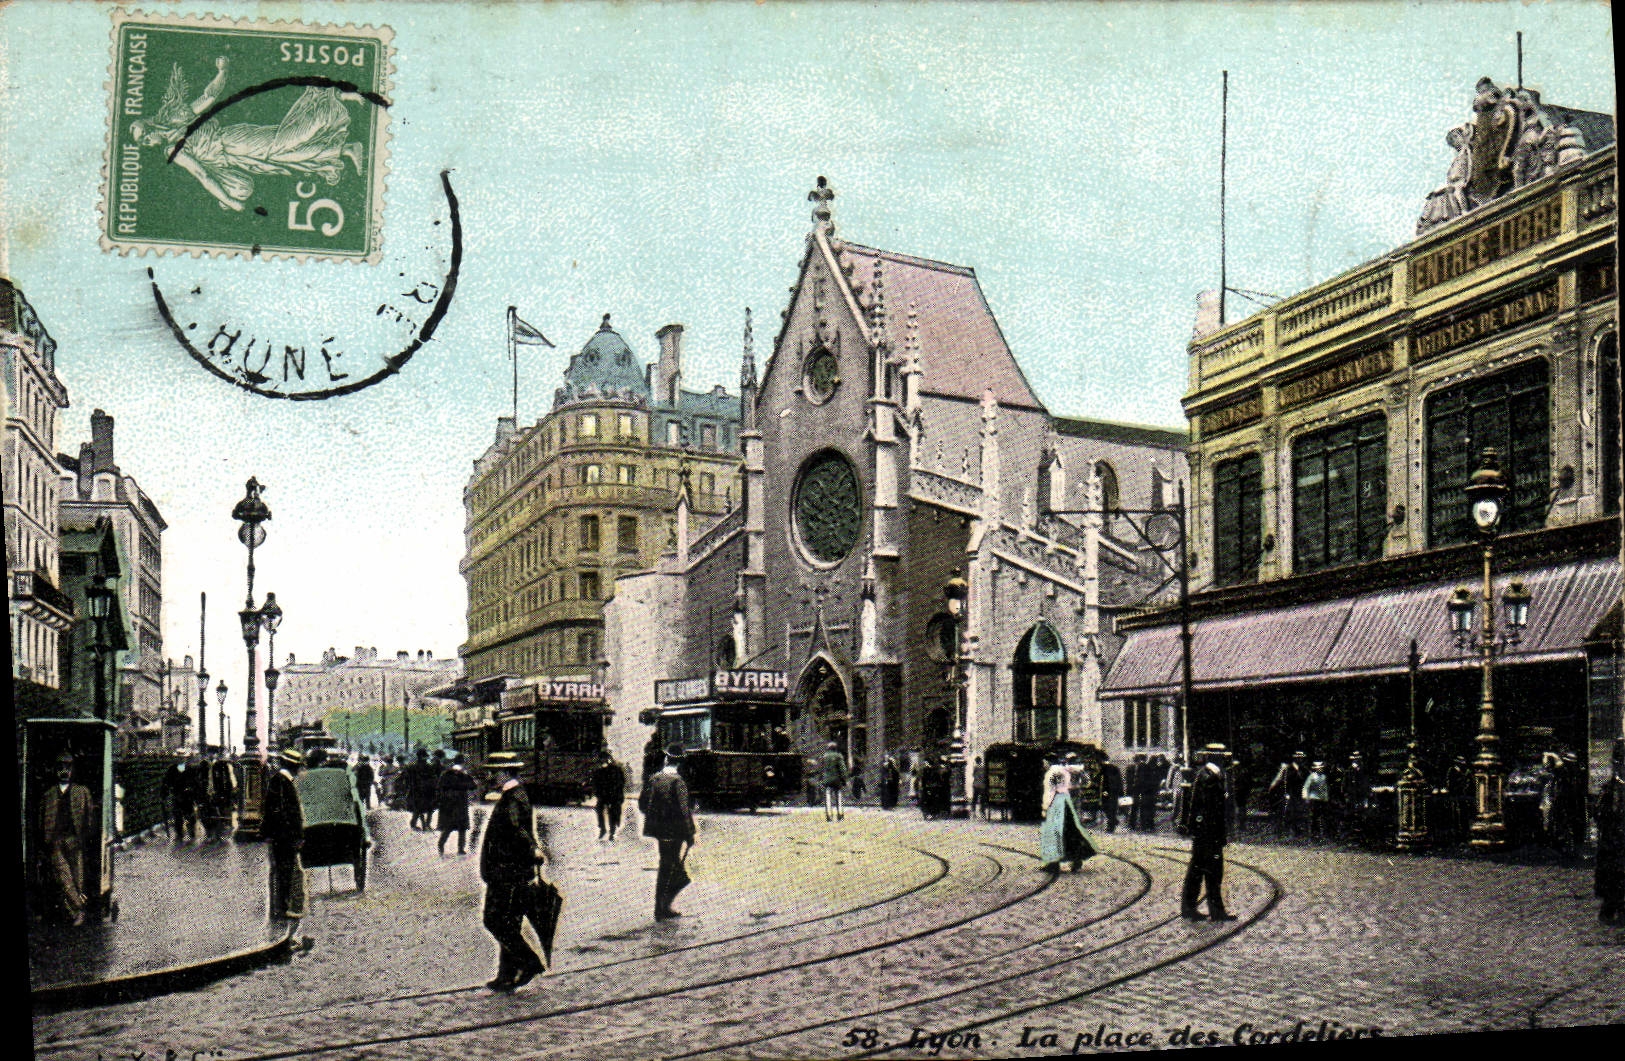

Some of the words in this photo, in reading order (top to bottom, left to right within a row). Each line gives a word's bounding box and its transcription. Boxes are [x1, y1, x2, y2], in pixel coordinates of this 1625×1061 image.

[280, 42, 365, 66] POSTES
[125, 33, 148, 115] FRANÇAISE
[538, 681, 605, 698] BYRRH
[715, 670, 788, 689] BYRRH
